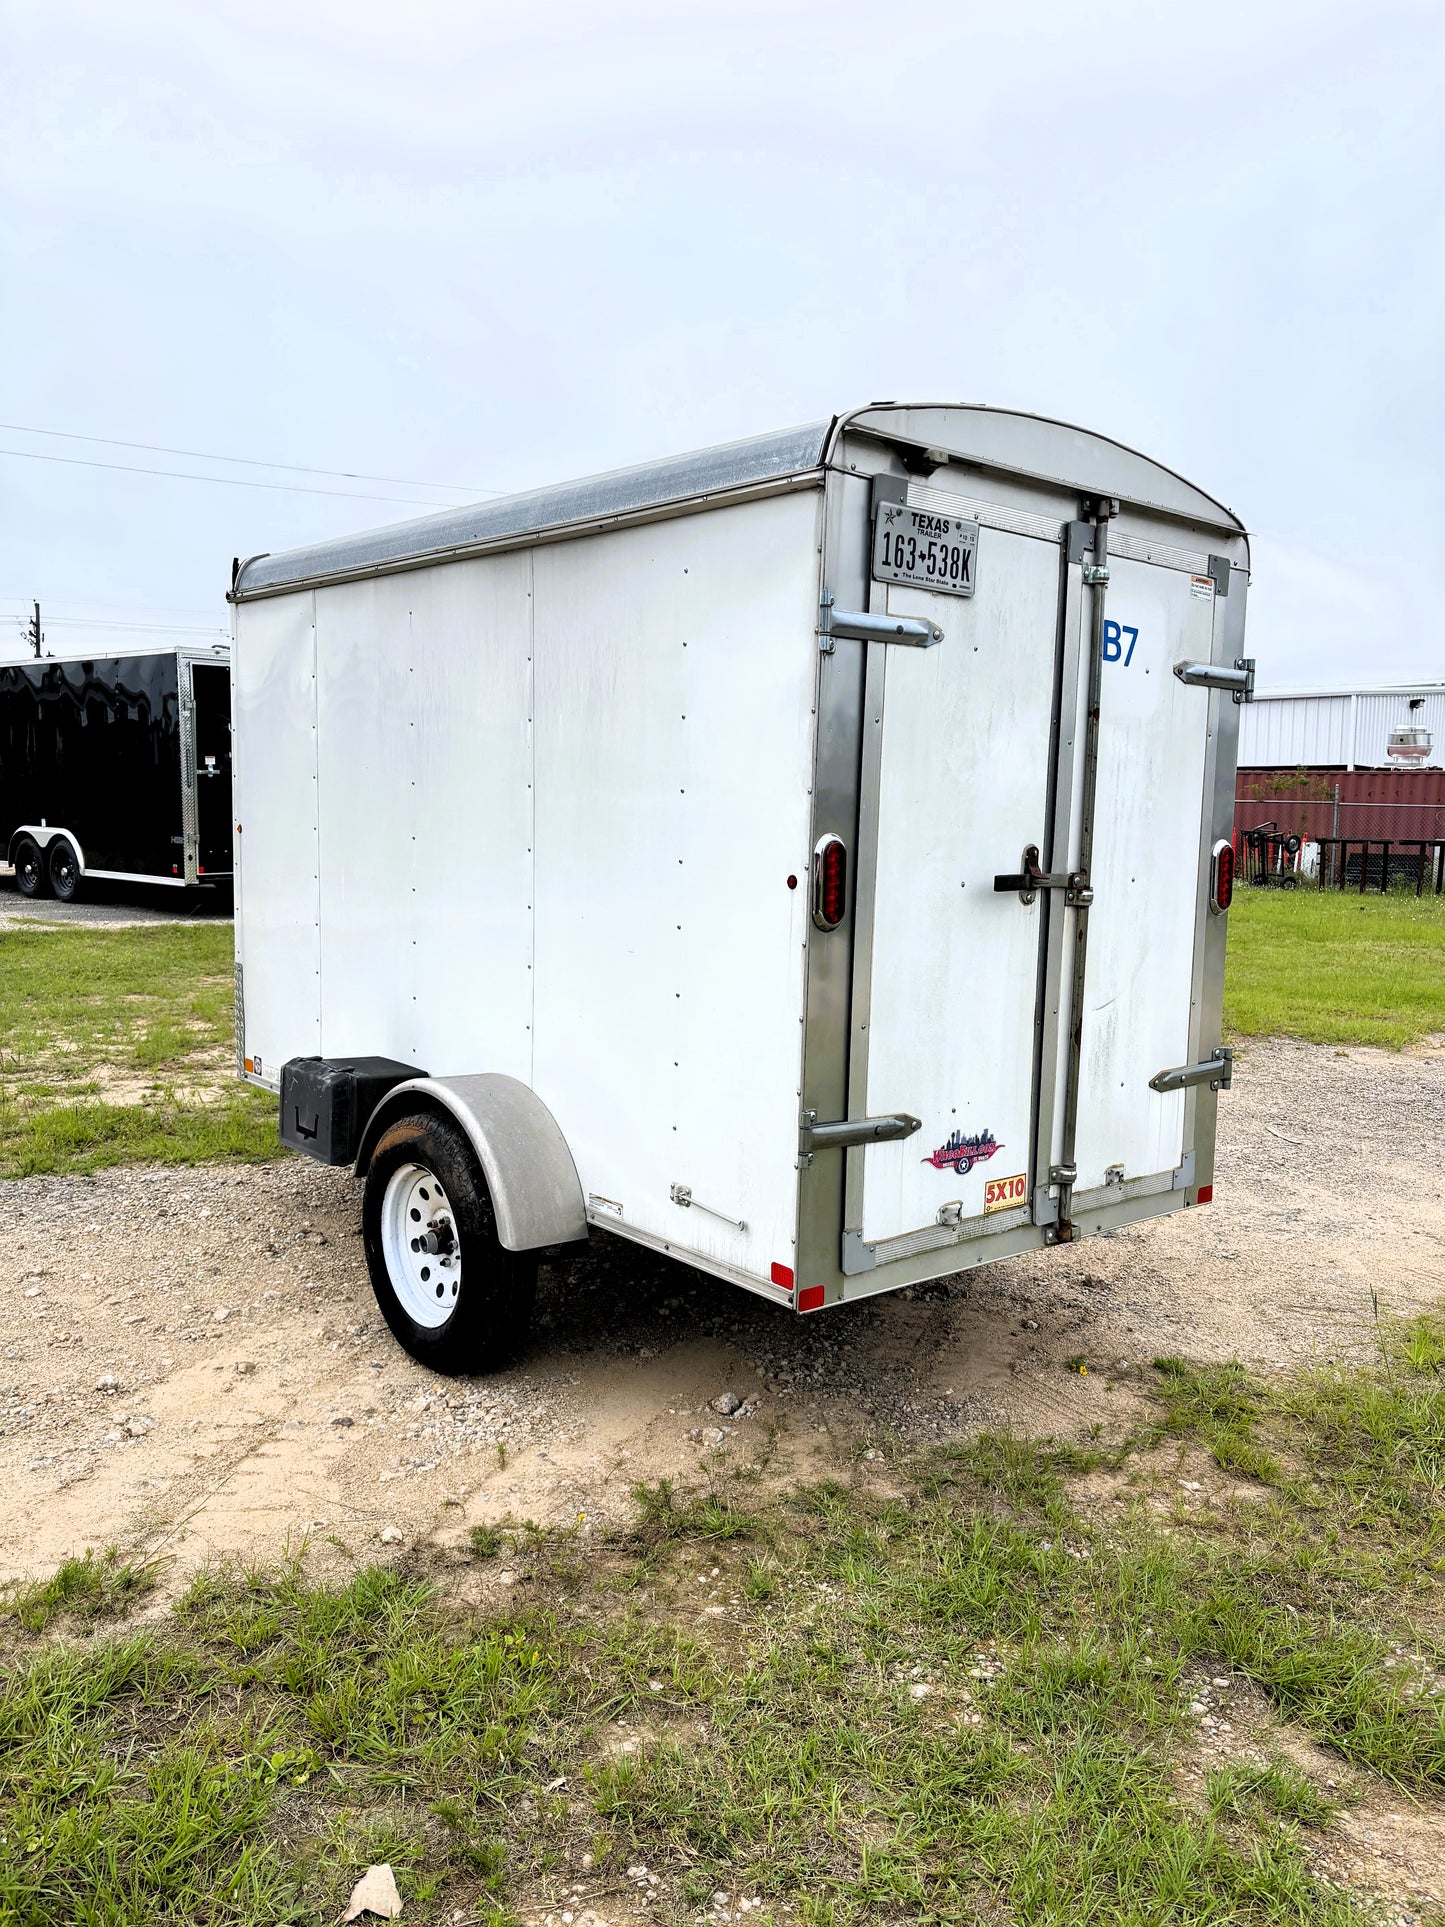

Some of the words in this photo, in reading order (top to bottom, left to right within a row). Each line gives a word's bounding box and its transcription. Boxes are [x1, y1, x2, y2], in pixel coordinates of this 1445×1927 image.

[911, 512, 950, 534] TEXAS
[917, 528, 942, 540] TRAILER
[881, 531, 917, 571] 163
[926, 541, 972, 582] 538K
[1103, 619, 1139, 667] B7
[986, 1178, 1025, 1204] 5X10
